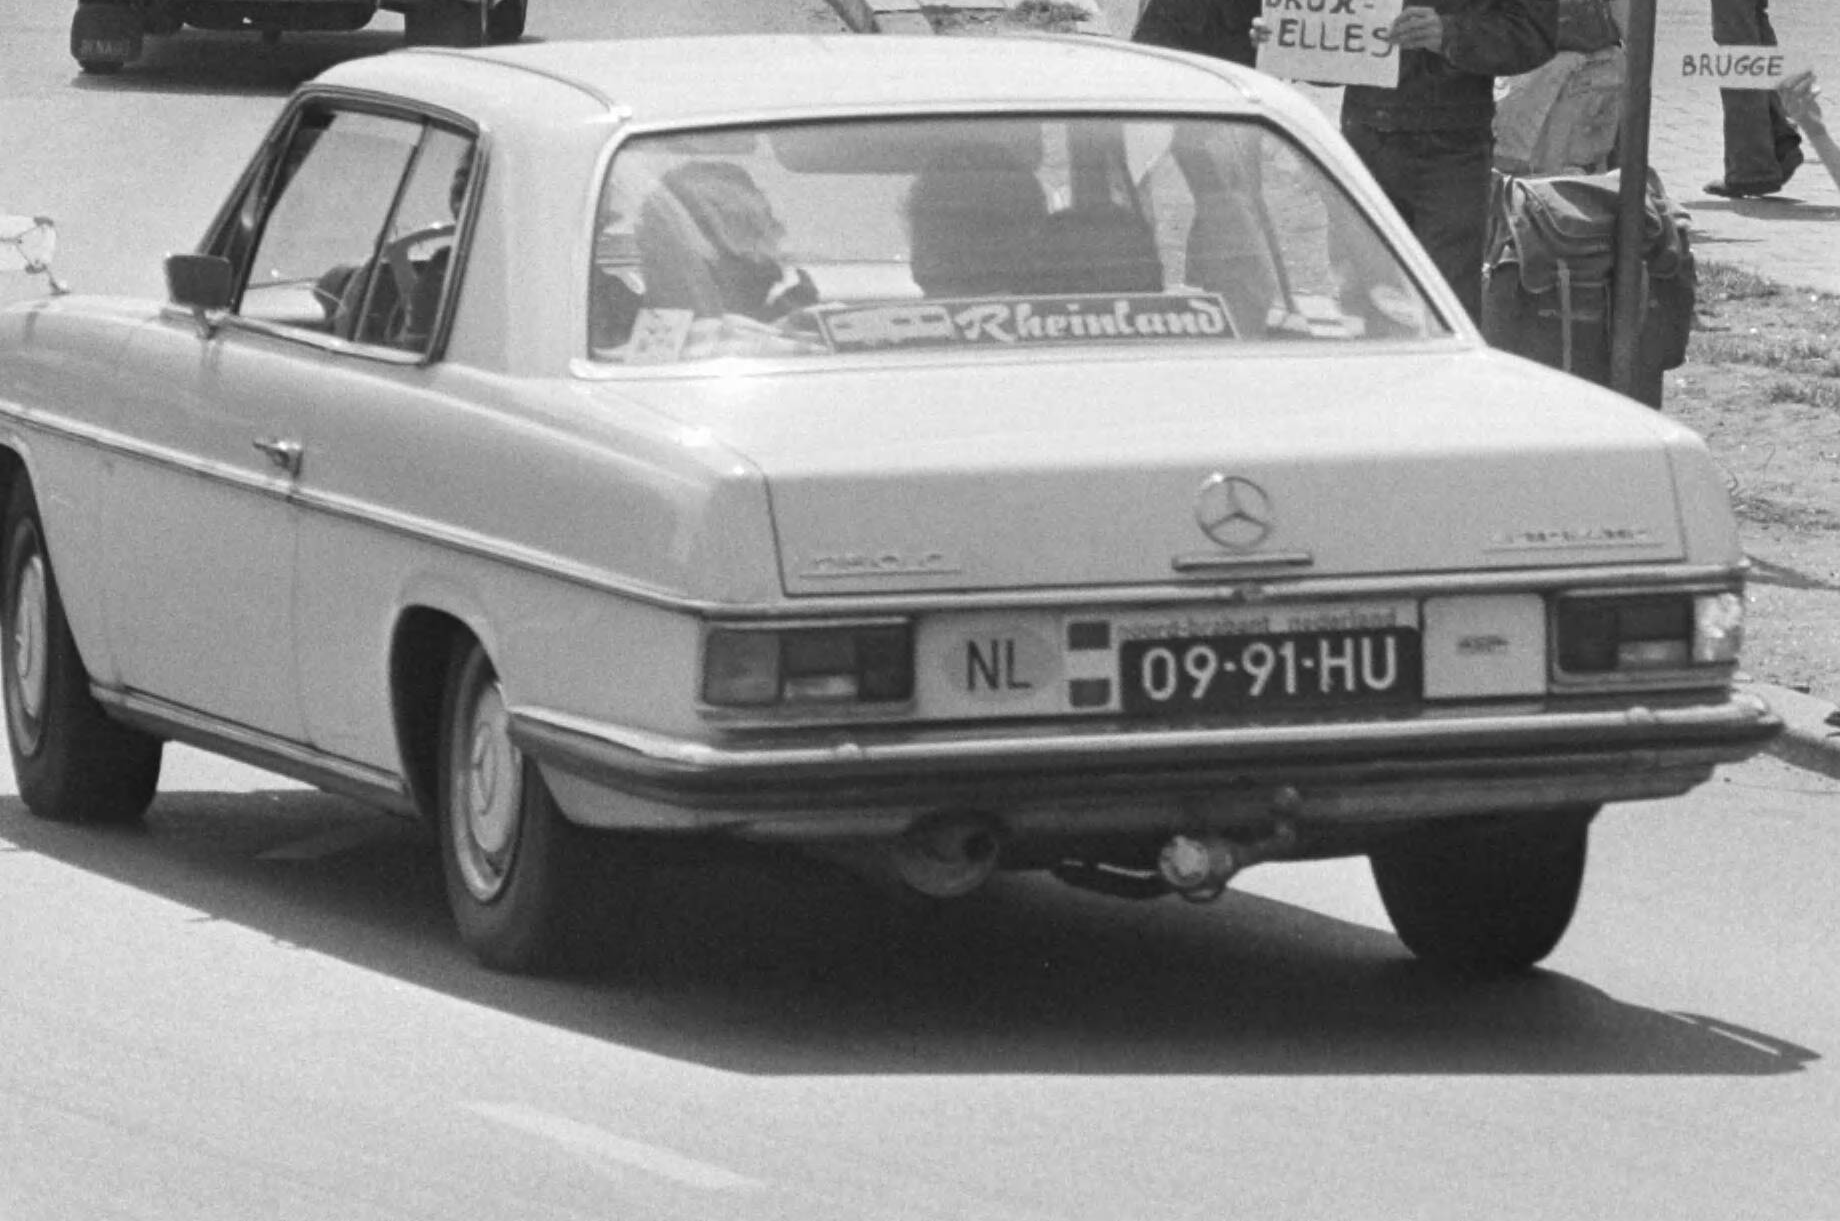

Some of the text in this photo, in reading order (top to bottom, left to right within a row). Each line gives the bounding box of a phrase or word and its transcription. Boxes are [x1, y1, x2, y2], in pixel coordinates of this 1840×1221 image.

[1278, 18, 1393, 58] ELLES
[1682, 53, 1785, 77] BRUGGE
[953, 299, 1226, 343] Rheinland
[967, 639, 1032, 691] NL
[1142, 637, 1397, 701] 09-91-HU
